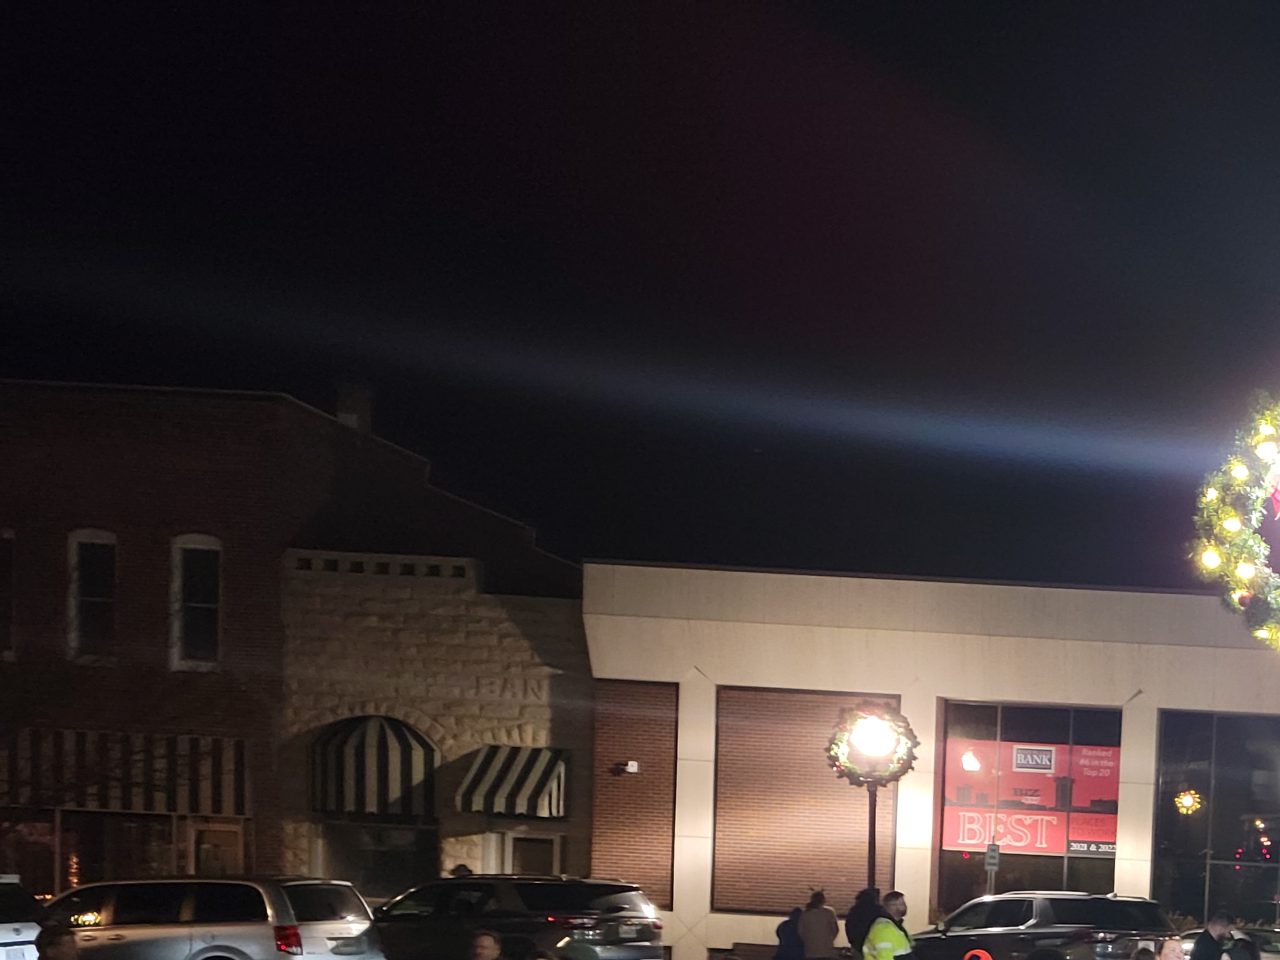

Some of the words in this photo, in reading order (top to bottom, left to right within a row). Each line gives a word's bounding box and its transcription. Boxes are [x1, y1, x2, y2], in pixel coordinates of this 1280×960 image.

[1082, 748, 1113, 757] Ranked
[1017, 753, 1050, 765] BANK
[1083, 767, 1098, 777] Top
[1098, 768, 1111, 777] 20
[957, 812, 1058, 848] BEST
[1089, 843, 1097, 851] &
